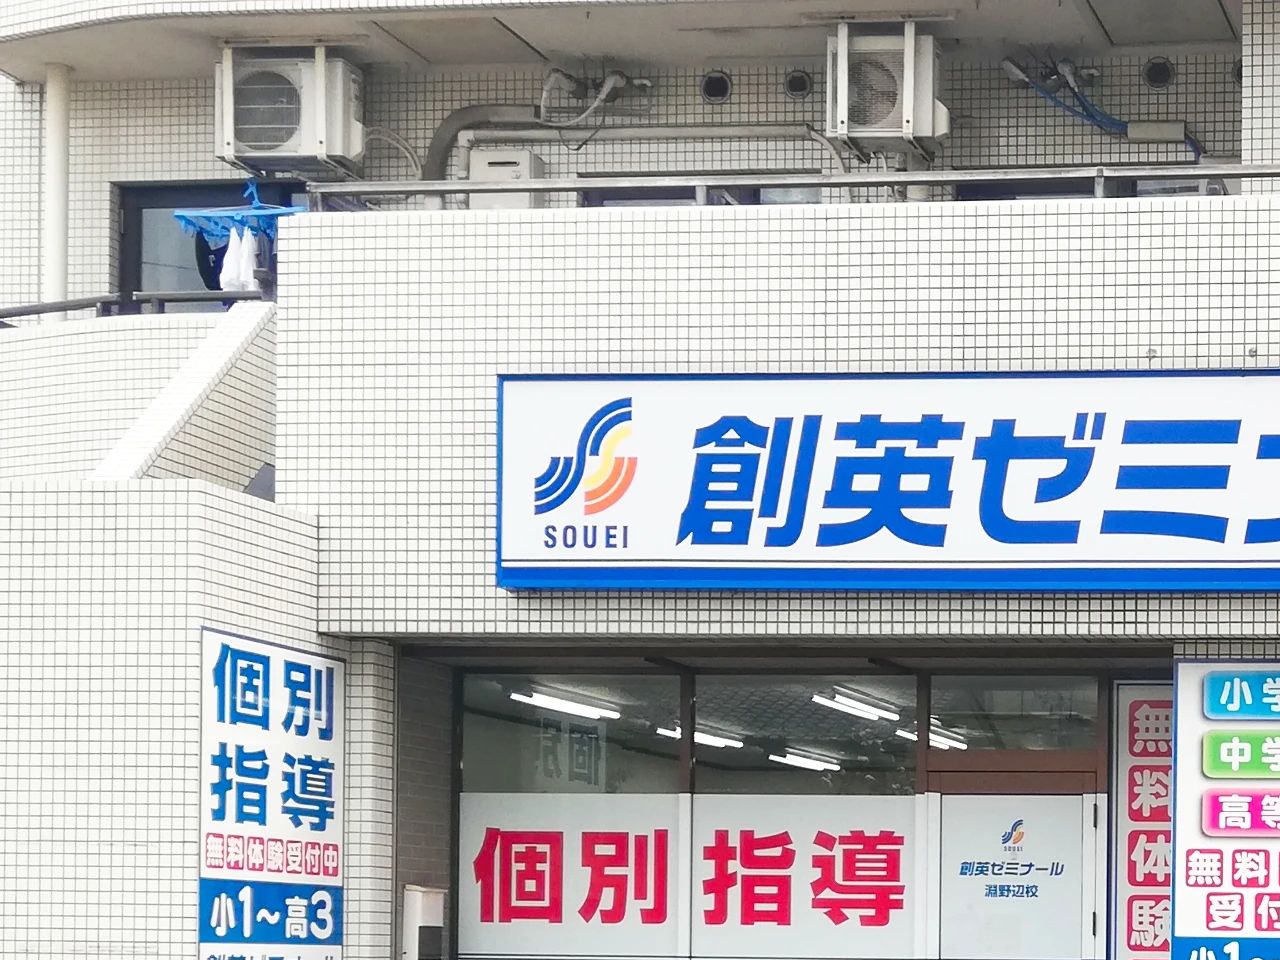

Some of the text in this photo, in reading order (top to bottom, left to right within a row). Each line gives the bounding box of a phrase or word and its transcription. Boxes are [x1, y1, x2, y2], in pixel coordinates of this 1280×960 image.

[543, 524, 629, 549] SOUEI
[212, 642, 335, 742] 個別
[211, 742, 335, 834] 指導
[206, 834, 339, 877] 無料体験受付中
[473, 827, 906, 926] 個別指導
[958, 861, 1065, 877] 創英ゼミナール
[984, 884, 1039, 898] 淵野辺校
